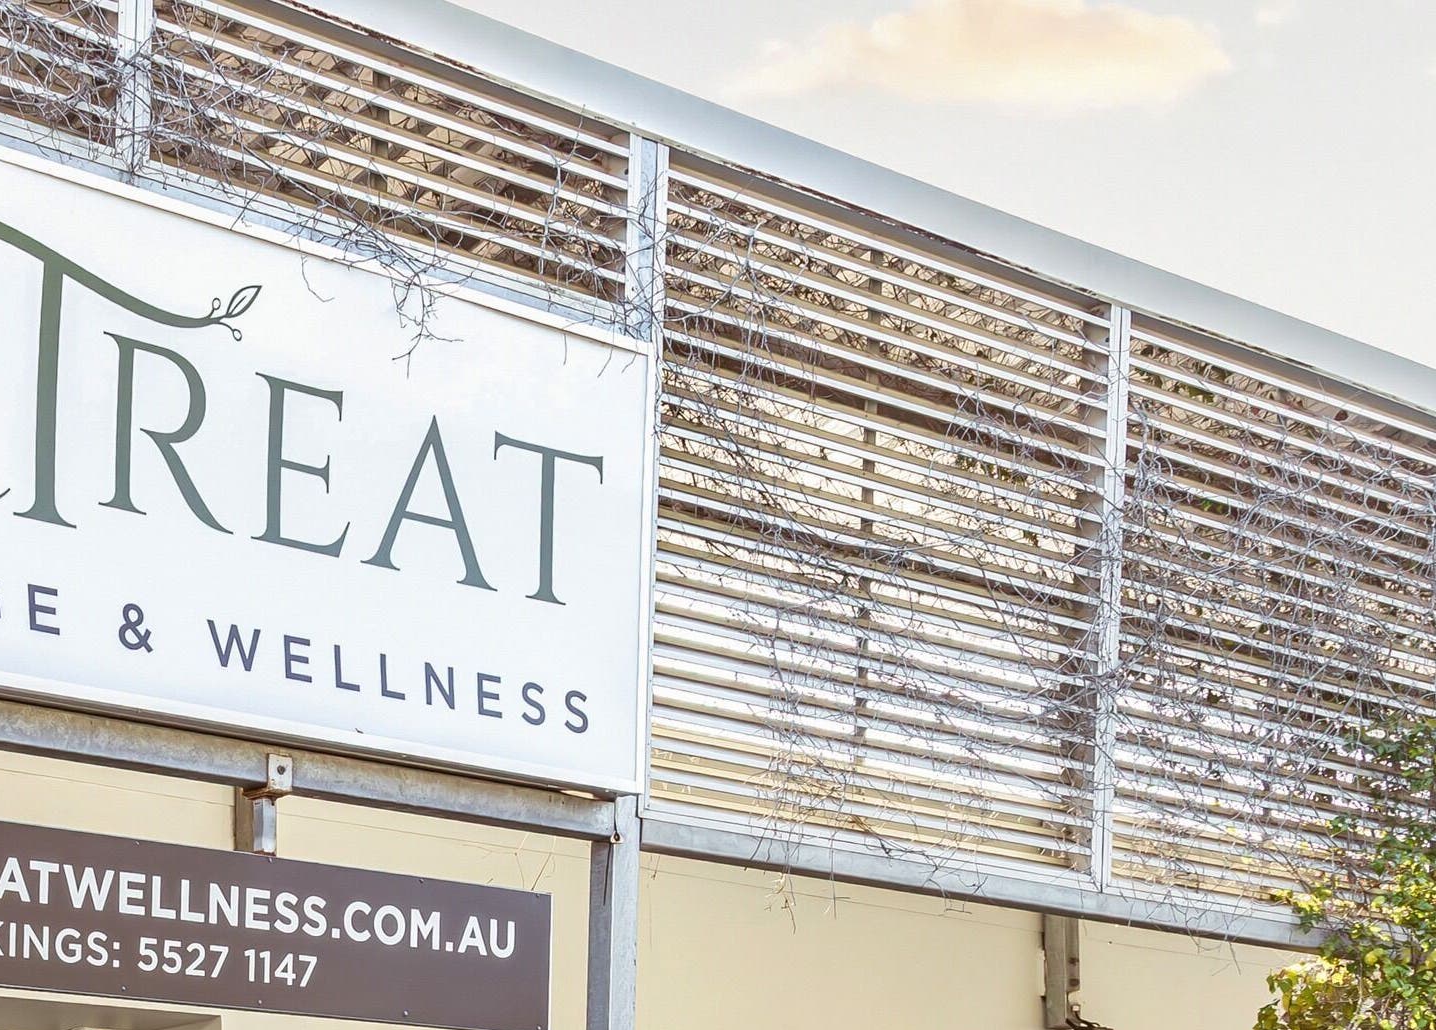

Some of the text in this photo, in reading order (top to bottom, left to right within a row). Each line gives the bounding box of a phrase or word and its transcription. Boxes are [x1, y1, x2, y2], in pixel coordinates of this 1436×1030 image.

[118, 604, 153, 653] &
[207, 620, 589, 734] WELLNESS
[137, 938, 229, 979] 5527
[245, 948, 317, 987] 1147
